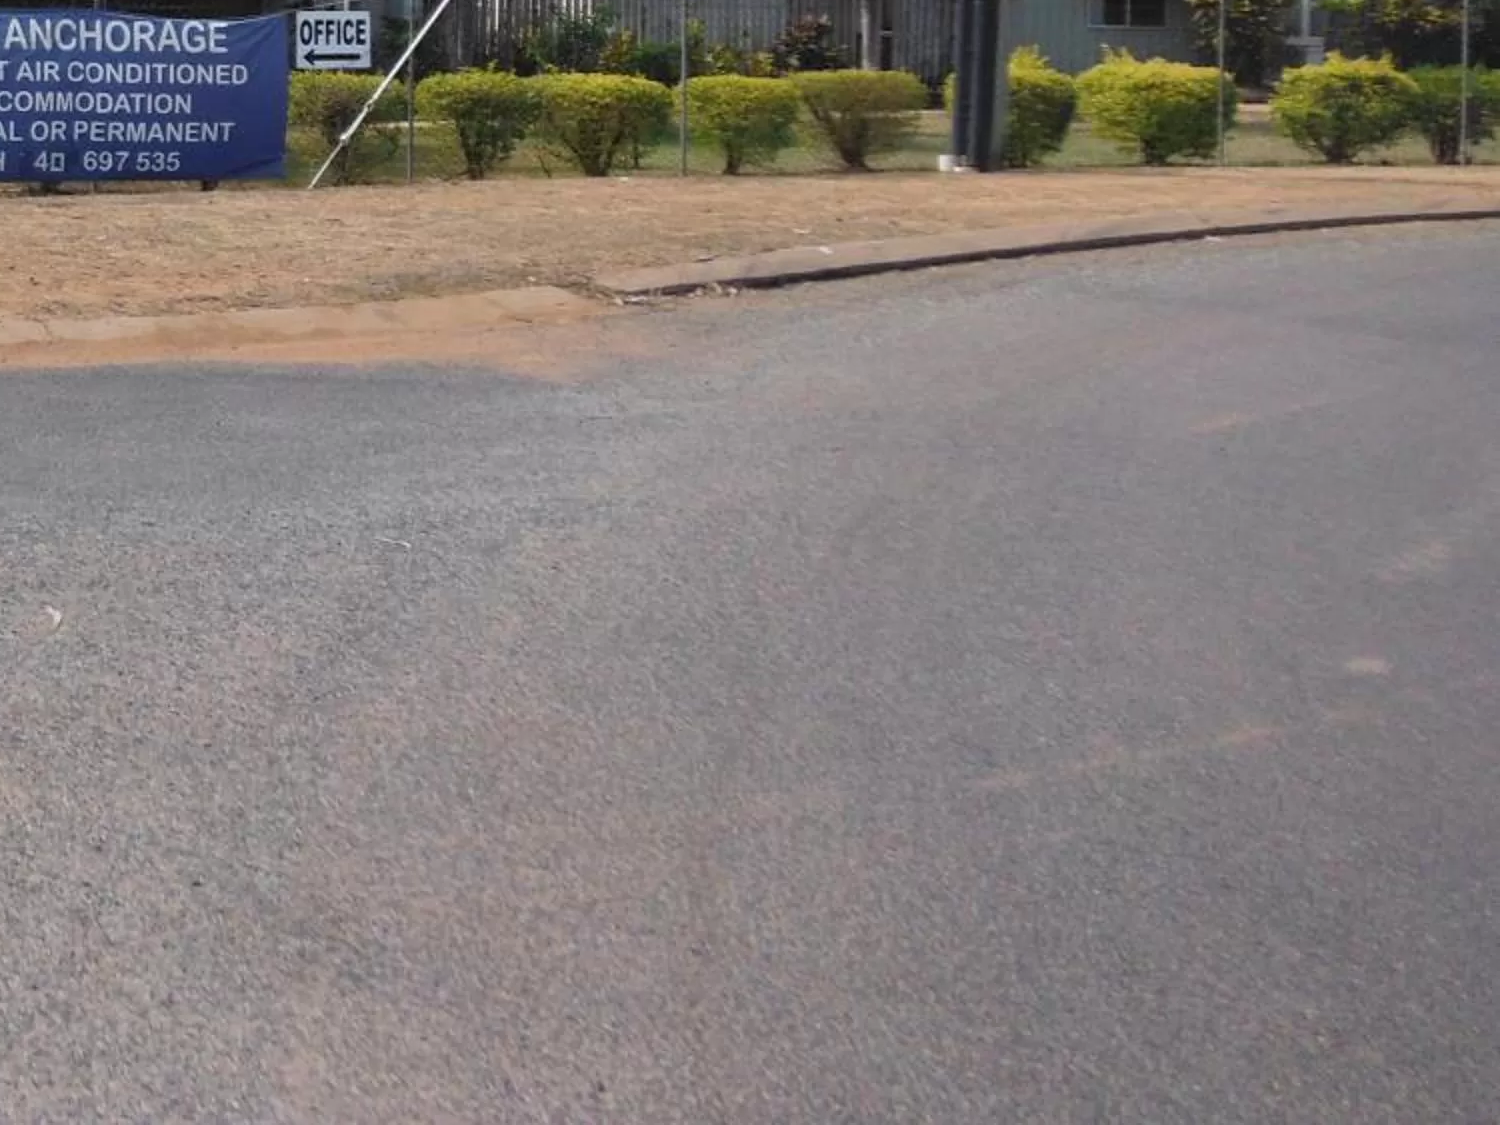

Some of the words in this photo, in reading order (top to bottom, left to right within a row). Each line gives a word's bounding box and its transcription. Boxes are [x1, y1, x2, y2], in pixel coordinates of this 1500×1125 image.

[4, 18, 229, 53] ANCHORAGE
[300, 19, 366, 46] OFFICE
[16, 60, 60, 82] AIR
[67, 61, 248, 85] CONDITIONED
[30, 120, 66, 141] OR
[73, 120, 236, 143] PERMANENT
[83, 150, 130, 172] 697
[135, 151, 181, 172] 535
